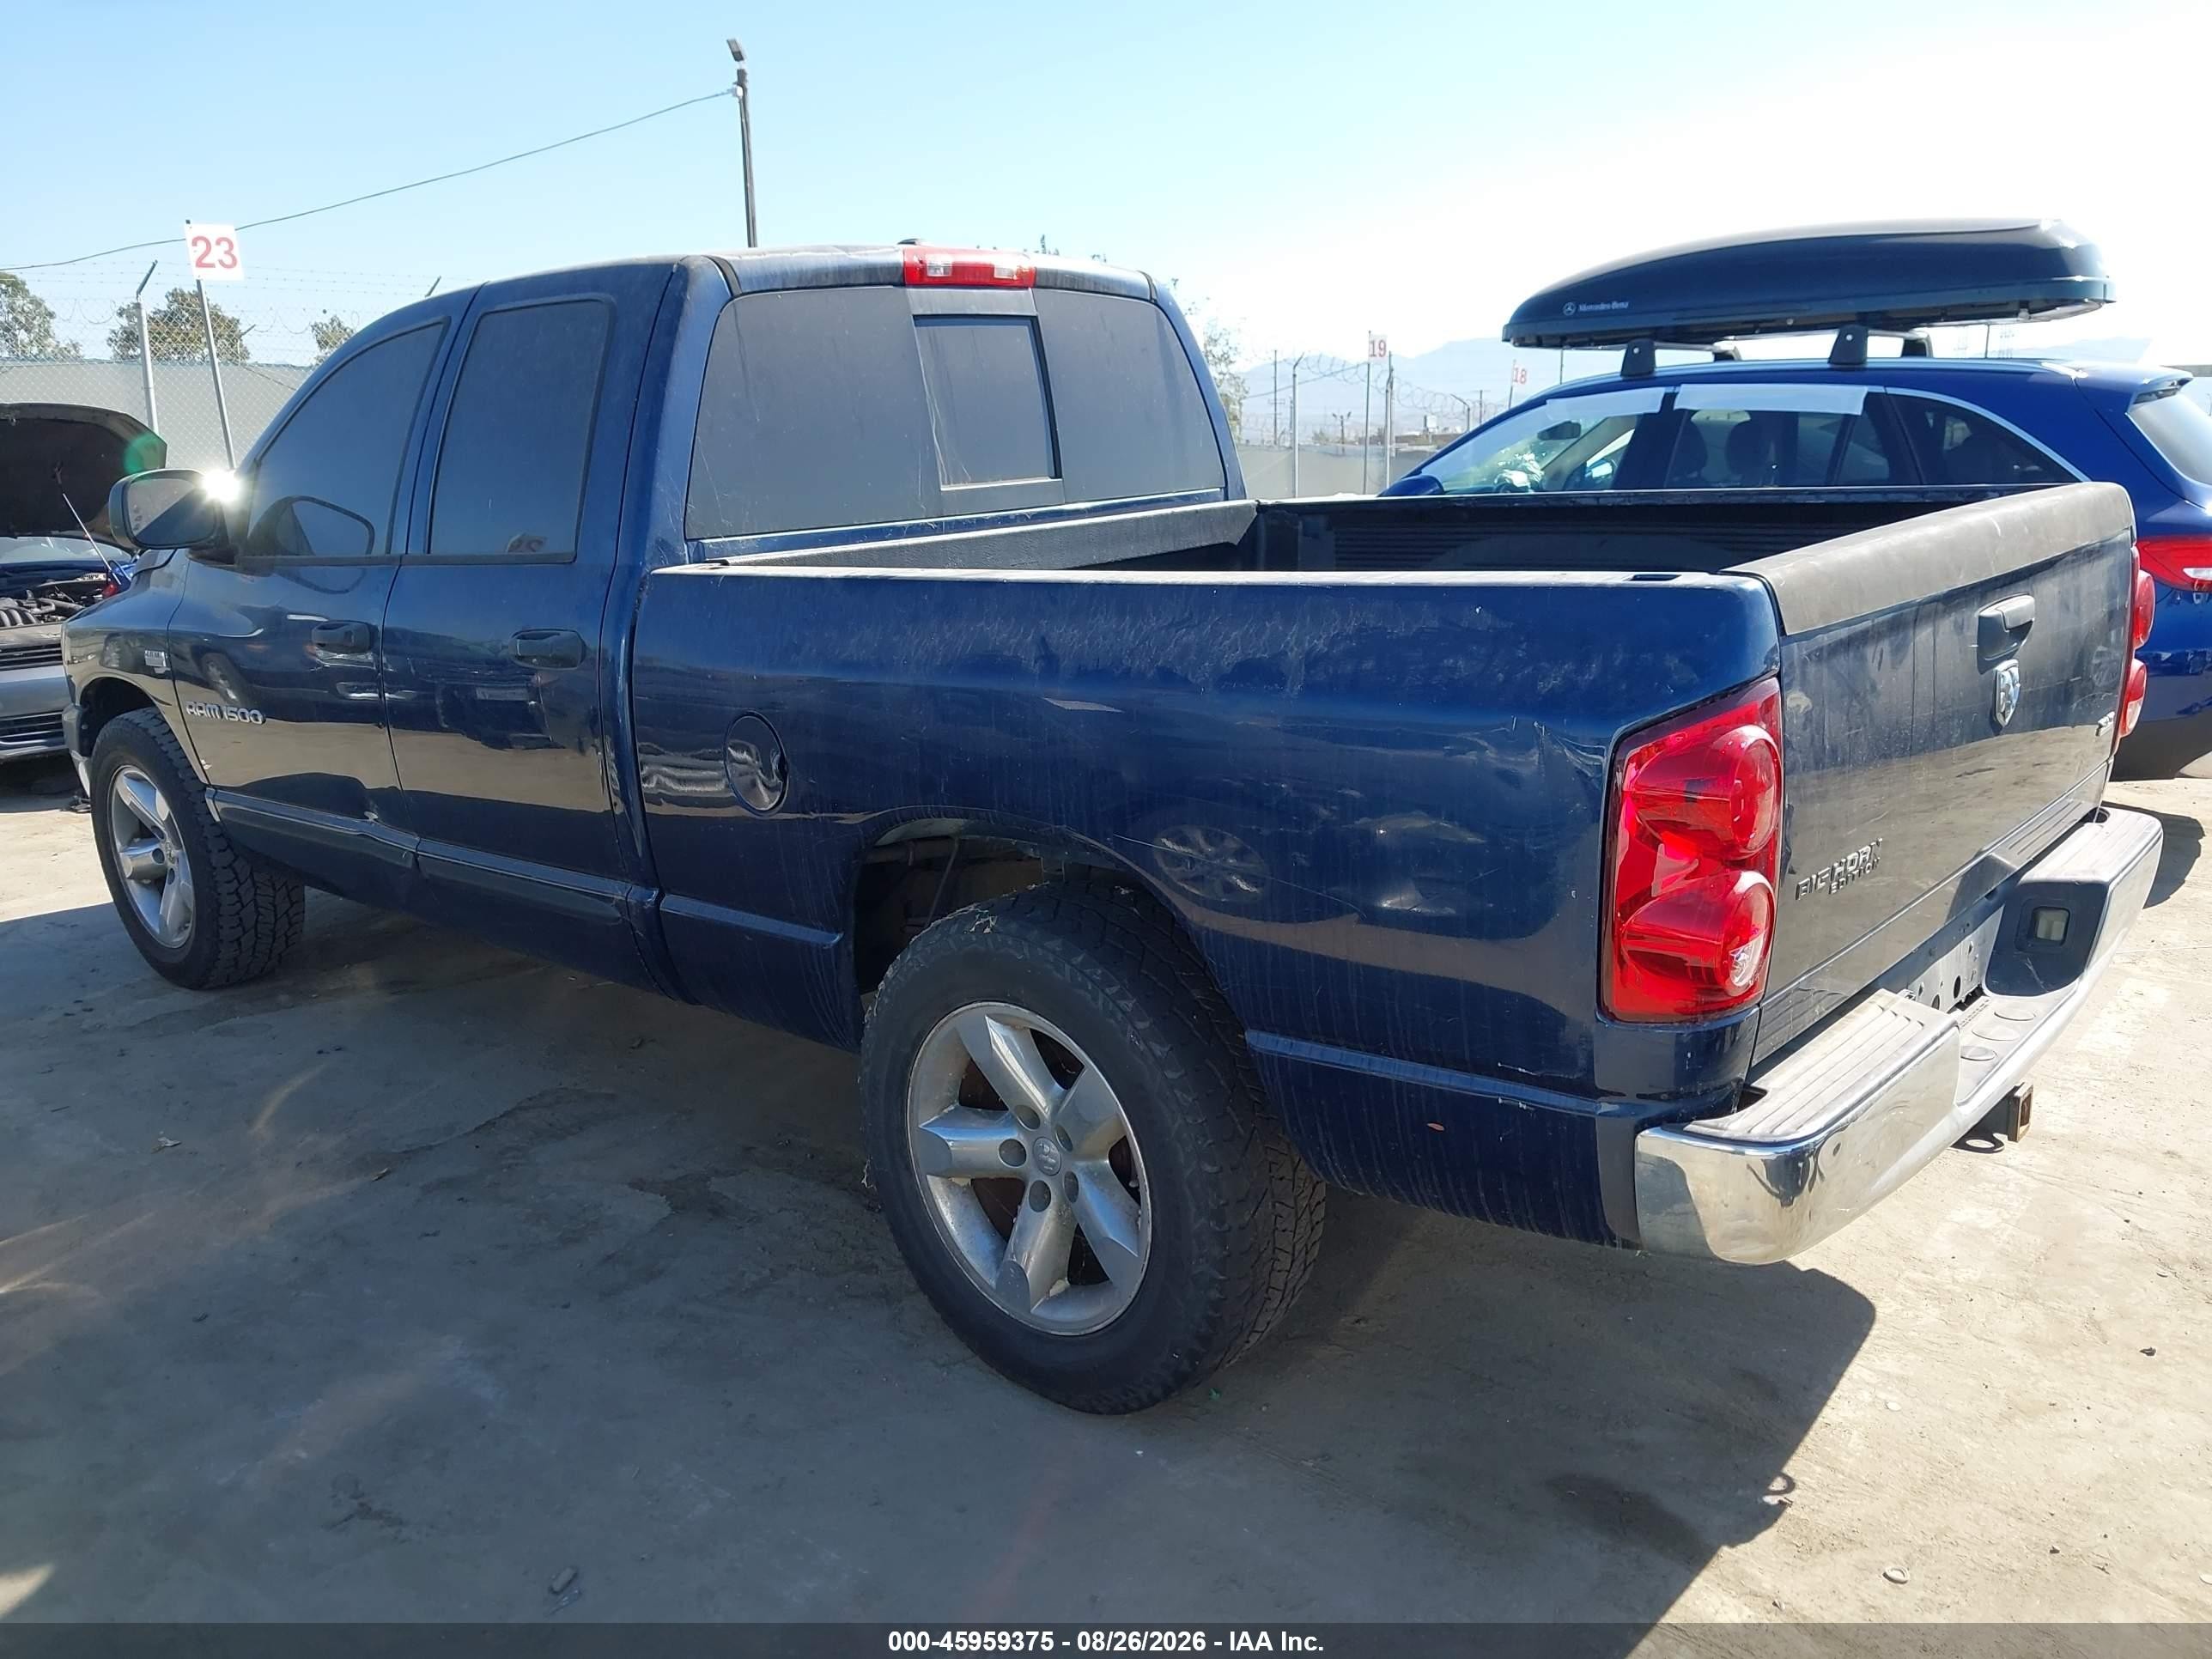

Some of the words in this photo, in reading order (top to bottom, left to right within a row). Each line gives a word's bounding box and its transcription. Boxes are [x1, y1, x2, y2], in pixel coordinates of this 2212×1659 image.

[191, 235, 237, 269] 23
[1369, 339, 1387, 357] 19
[1513, 368, 1527, 385] 18
[185, 701, 221, 720] RAM
[222, 705, 265, 725] 1500
